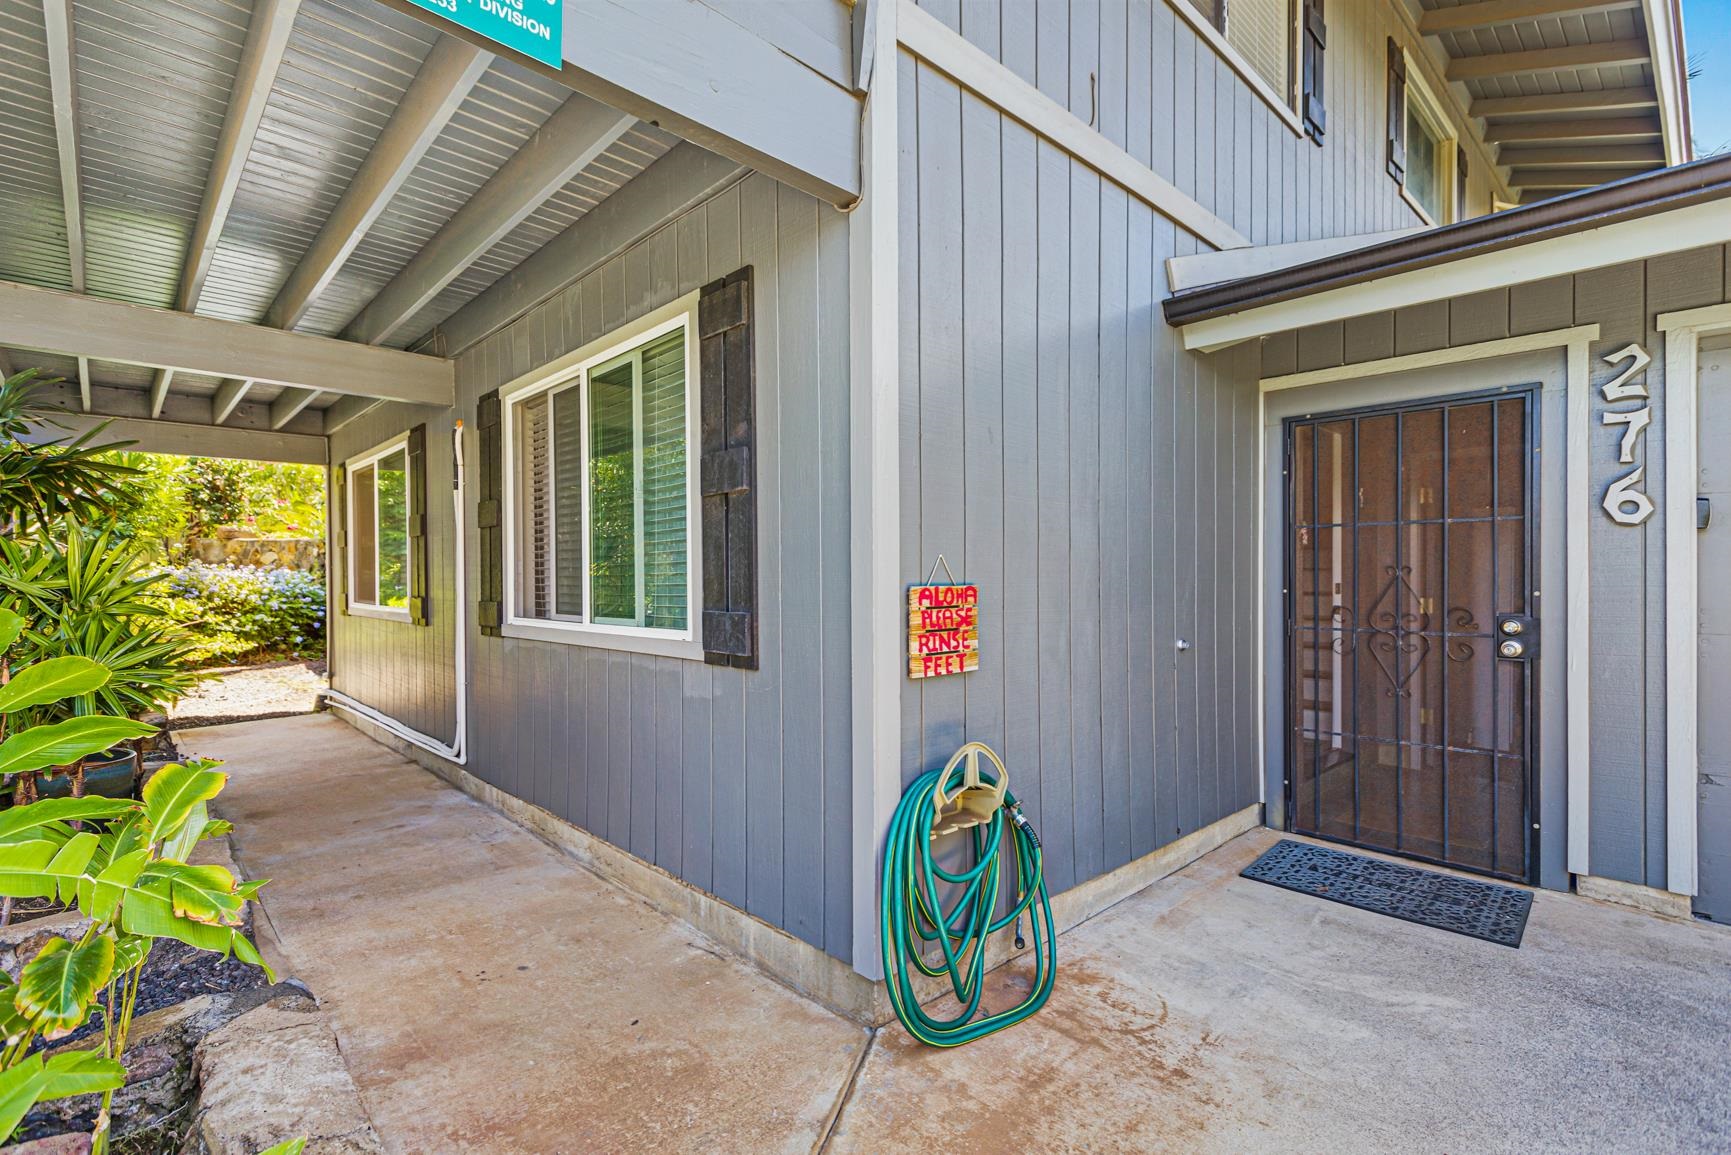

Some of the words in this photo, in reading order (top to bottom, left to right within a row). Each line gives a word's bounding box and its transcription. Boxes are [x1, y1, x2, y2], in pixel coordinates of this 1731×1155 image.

[480, 0, 550, 41] DIVISION
[1602, 343, 1655, 525] 276
[918, 586, 978, 607] ALOHA
[920, 607, 973, 629] PLEASE
[918, 630, 971, 653] RINSE
[922, 653, 967, 677] FEET
